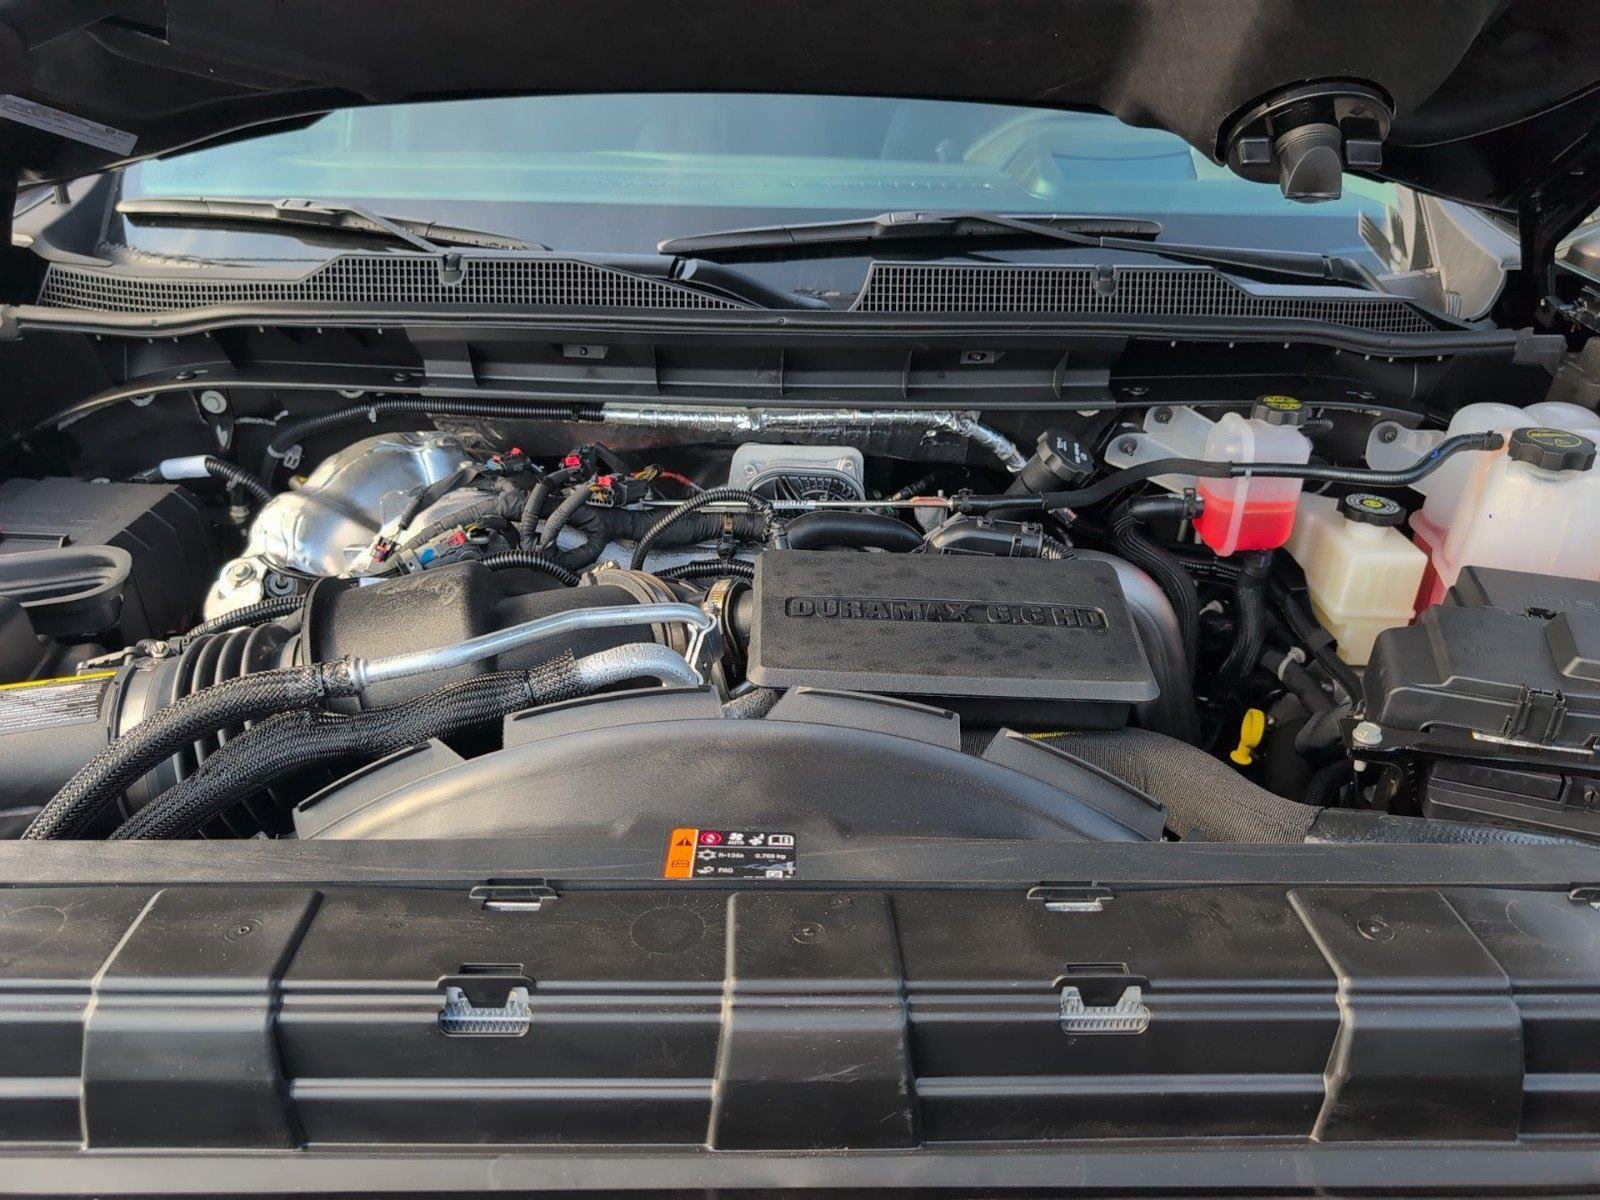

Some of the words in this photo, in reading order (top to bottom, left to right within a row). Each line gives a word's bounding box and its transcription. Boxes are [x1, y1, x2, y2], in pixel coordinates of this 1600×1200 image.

[790, 598, 973, 623] DURAMAX
[986, 604, 1046, 625] 6.6
[1051, 606, 1104, 628] HD
